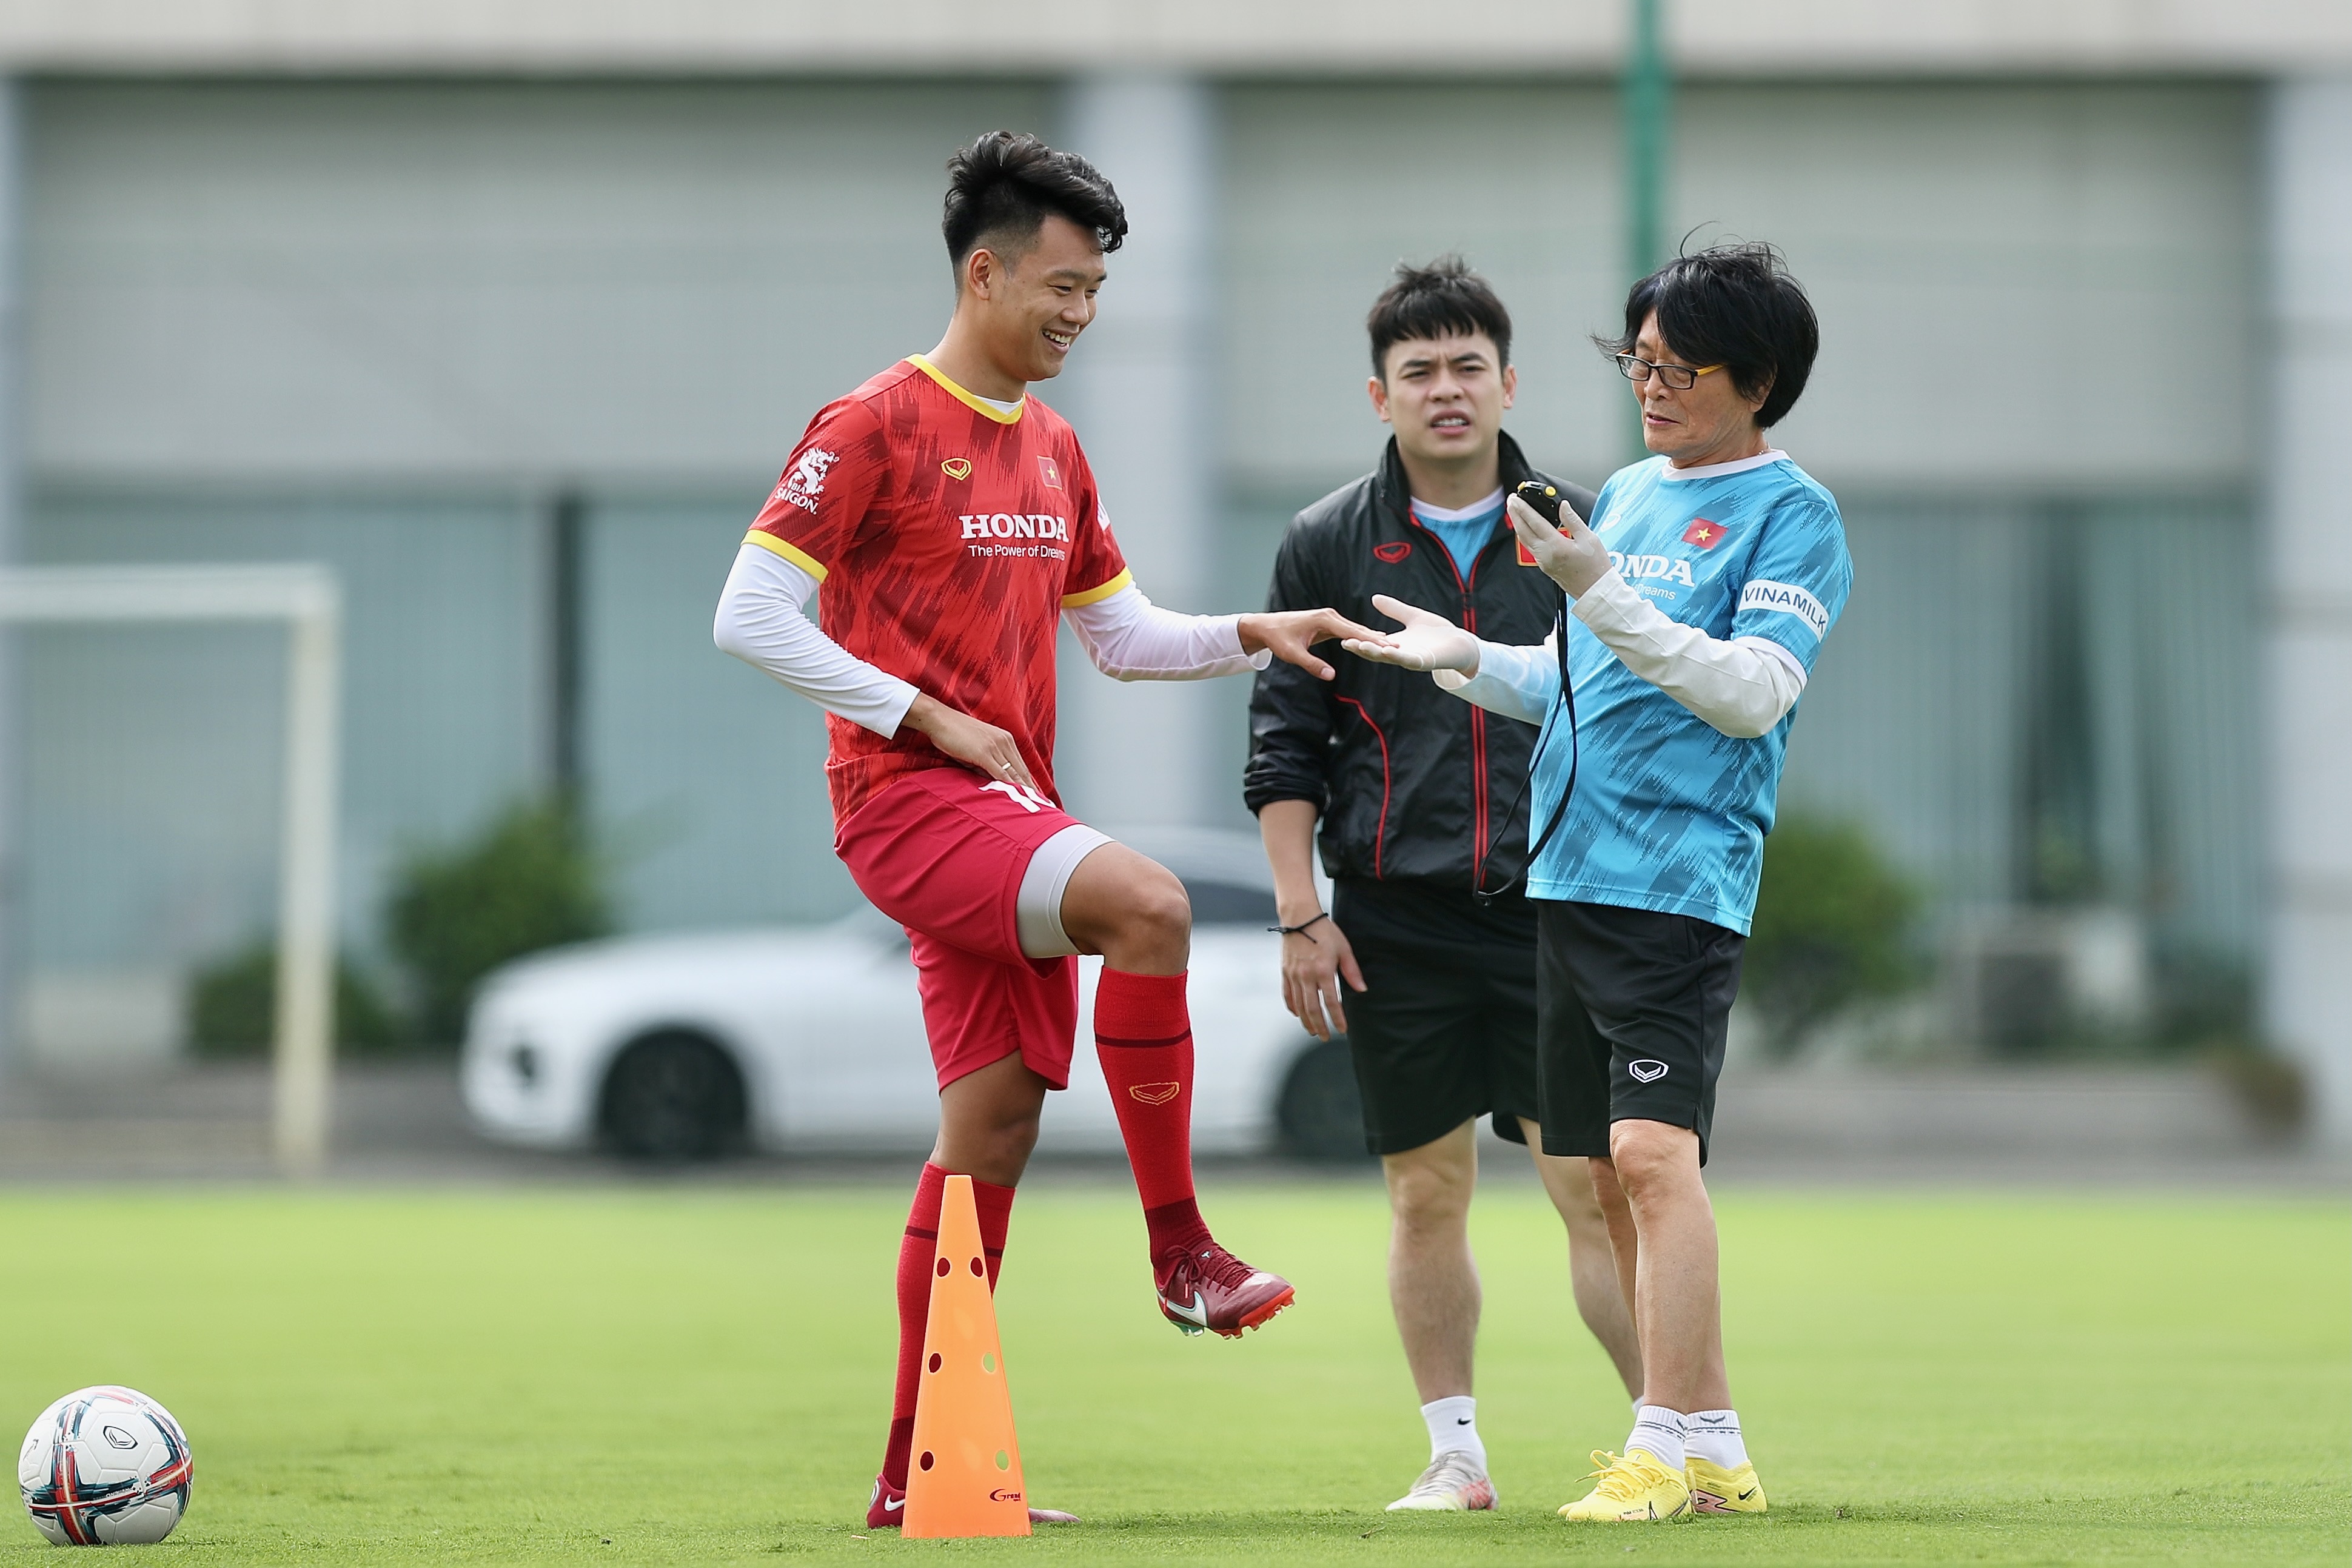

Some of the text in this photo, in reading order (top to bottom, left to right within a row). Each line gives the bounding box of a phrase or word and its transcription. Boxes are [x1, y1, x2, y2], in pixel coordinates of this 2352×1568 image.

[791, 483, 806, 495] BIA
[959, 513, 1070, 543] HONDA
[968, 544, 1065, 561] The Power of Dres
[1607, 551, 1695, 588] ONDA
[1637, 583, 1677, 600] Dreams
[1745, 587, 1826, 634] VINAMILK
